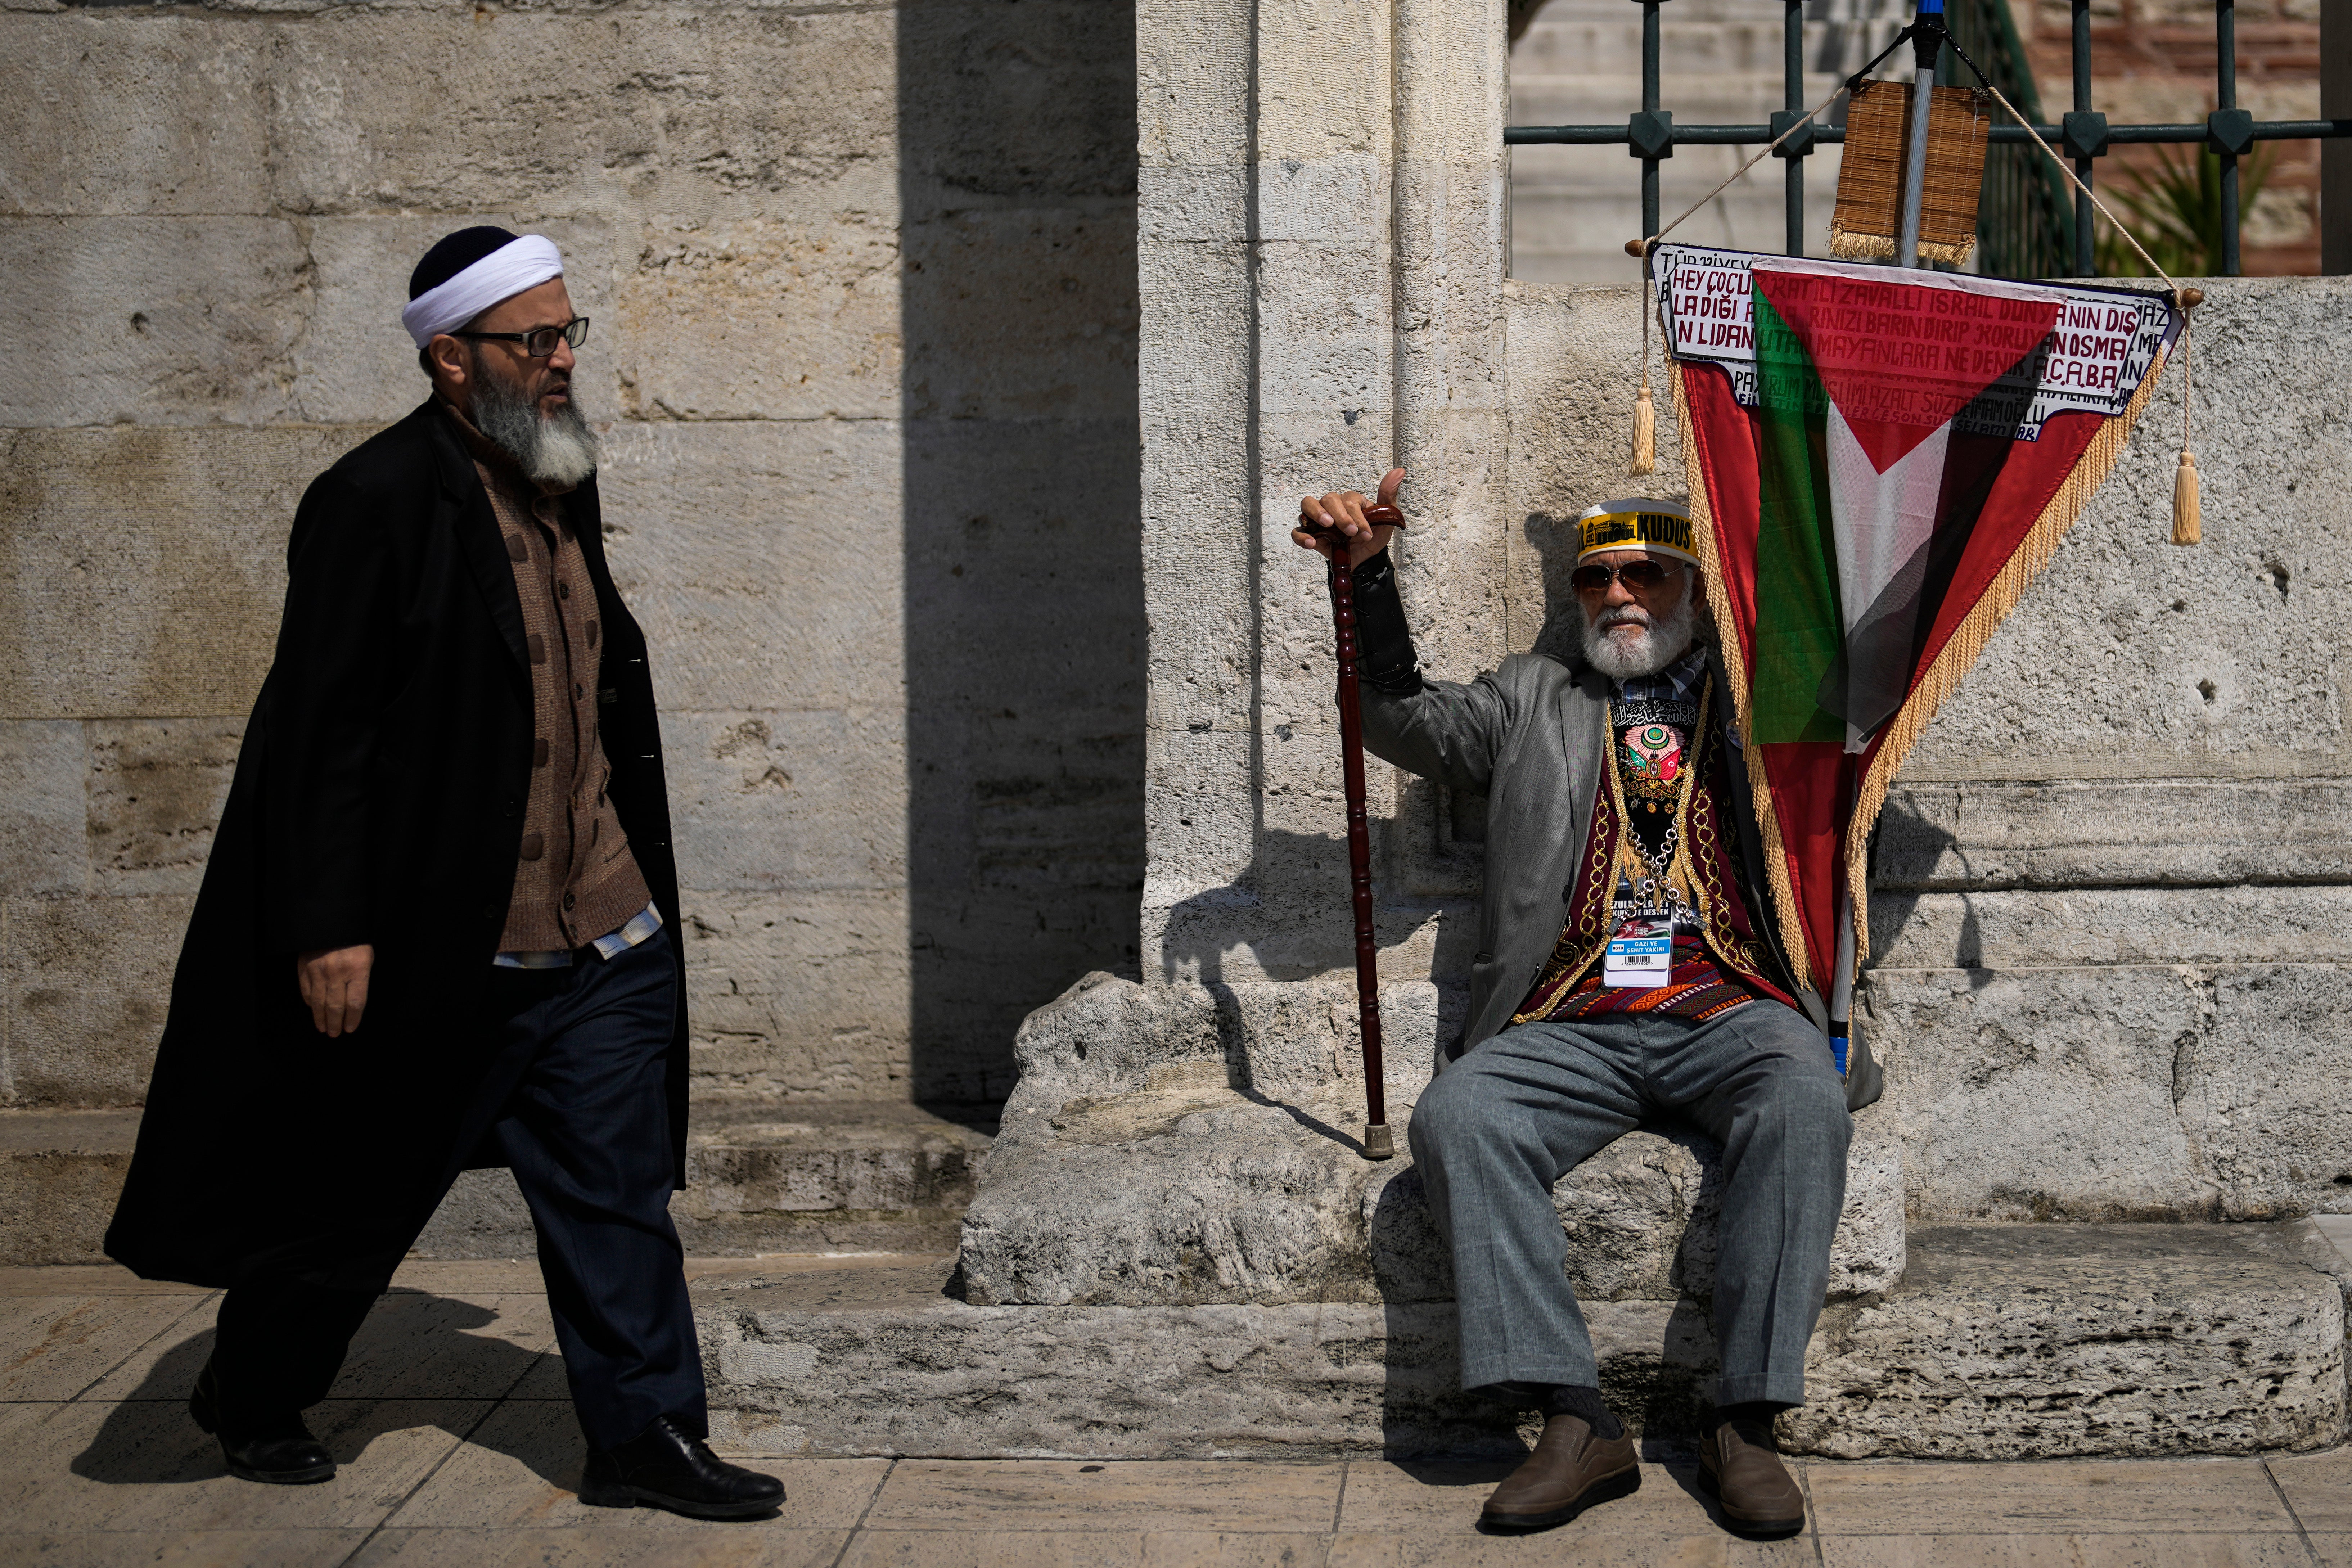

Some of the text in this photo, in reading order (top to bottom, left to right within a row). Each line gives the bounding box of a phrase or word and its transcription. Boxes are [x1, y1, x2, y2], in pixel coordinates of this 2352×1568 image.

[1673, 269, 1706, 291] HEY
[2105, 309, 2136, 336] DIŞ
[1637, 514, 1691, 550] KUDÜS
